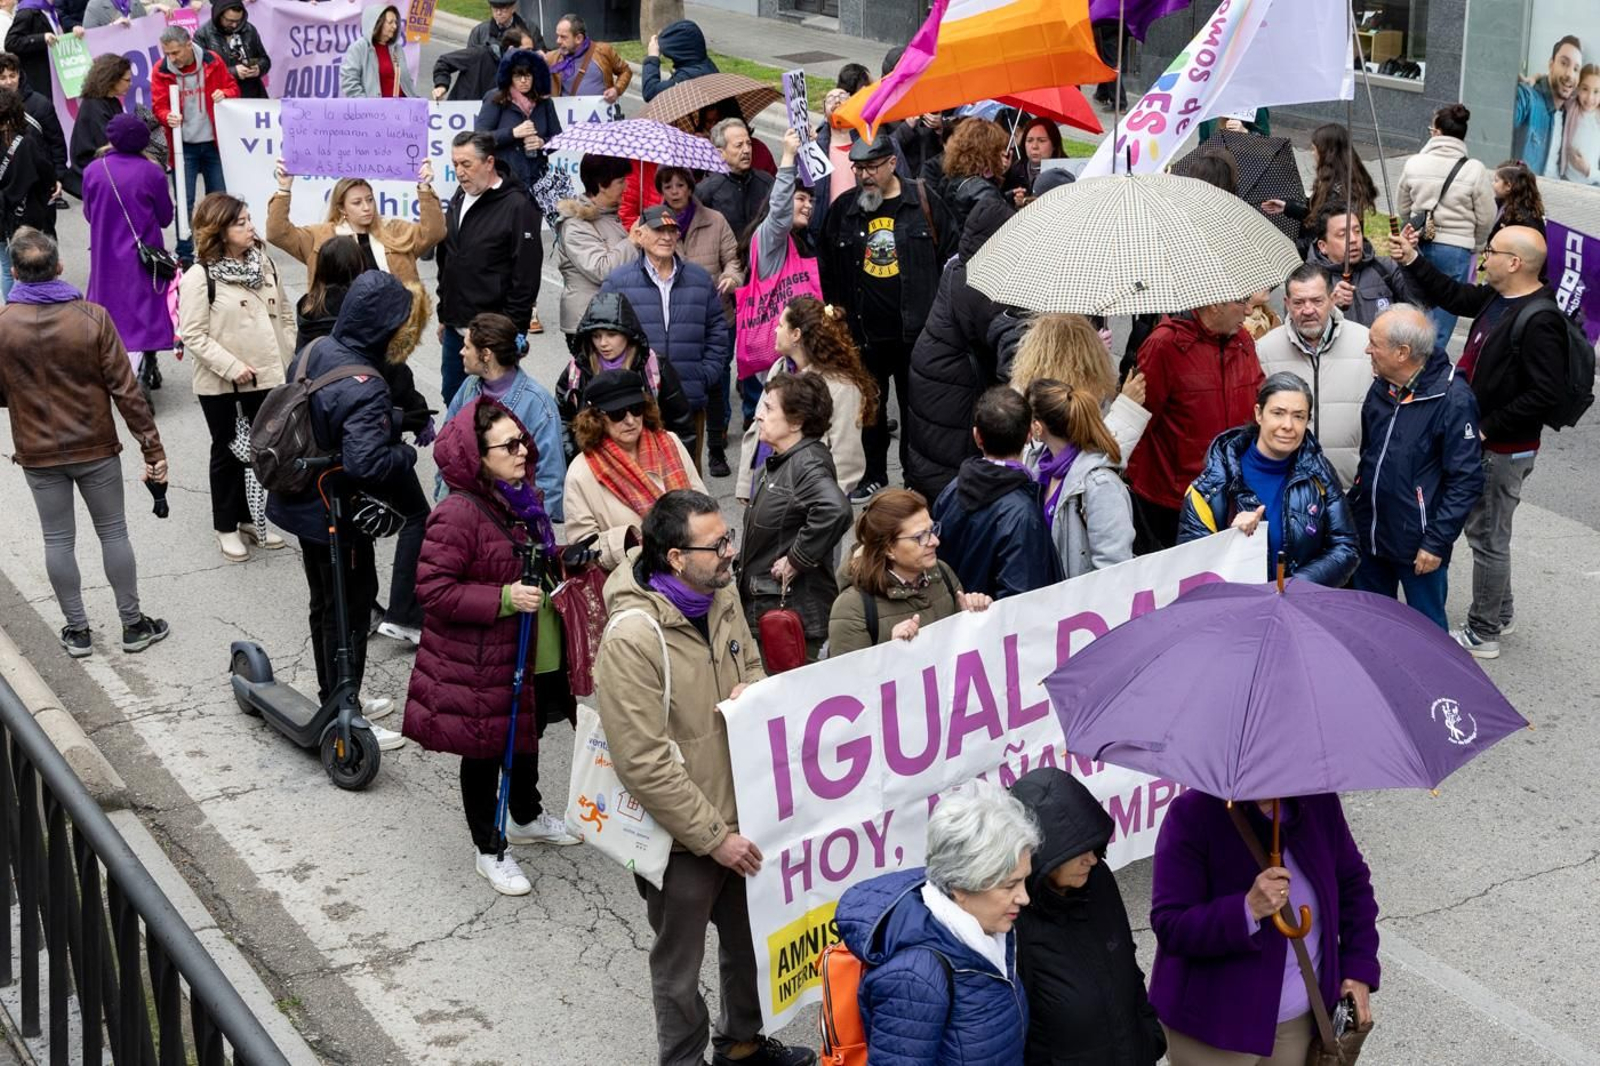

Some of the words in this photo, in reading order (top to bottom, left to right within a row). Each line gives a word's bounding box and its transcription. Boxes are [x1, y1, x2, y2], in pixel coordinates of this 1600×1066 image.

[291, 103, 313, 121] Se
[315, 163, 403, 177] ASESINADAS
[768, 571, 1226, 821] IGUALD
[780, 809, 904, 904] HOY,
[777, 918, 842, 979] AMNIS
[778, 961, 822, 1003] INTERN
